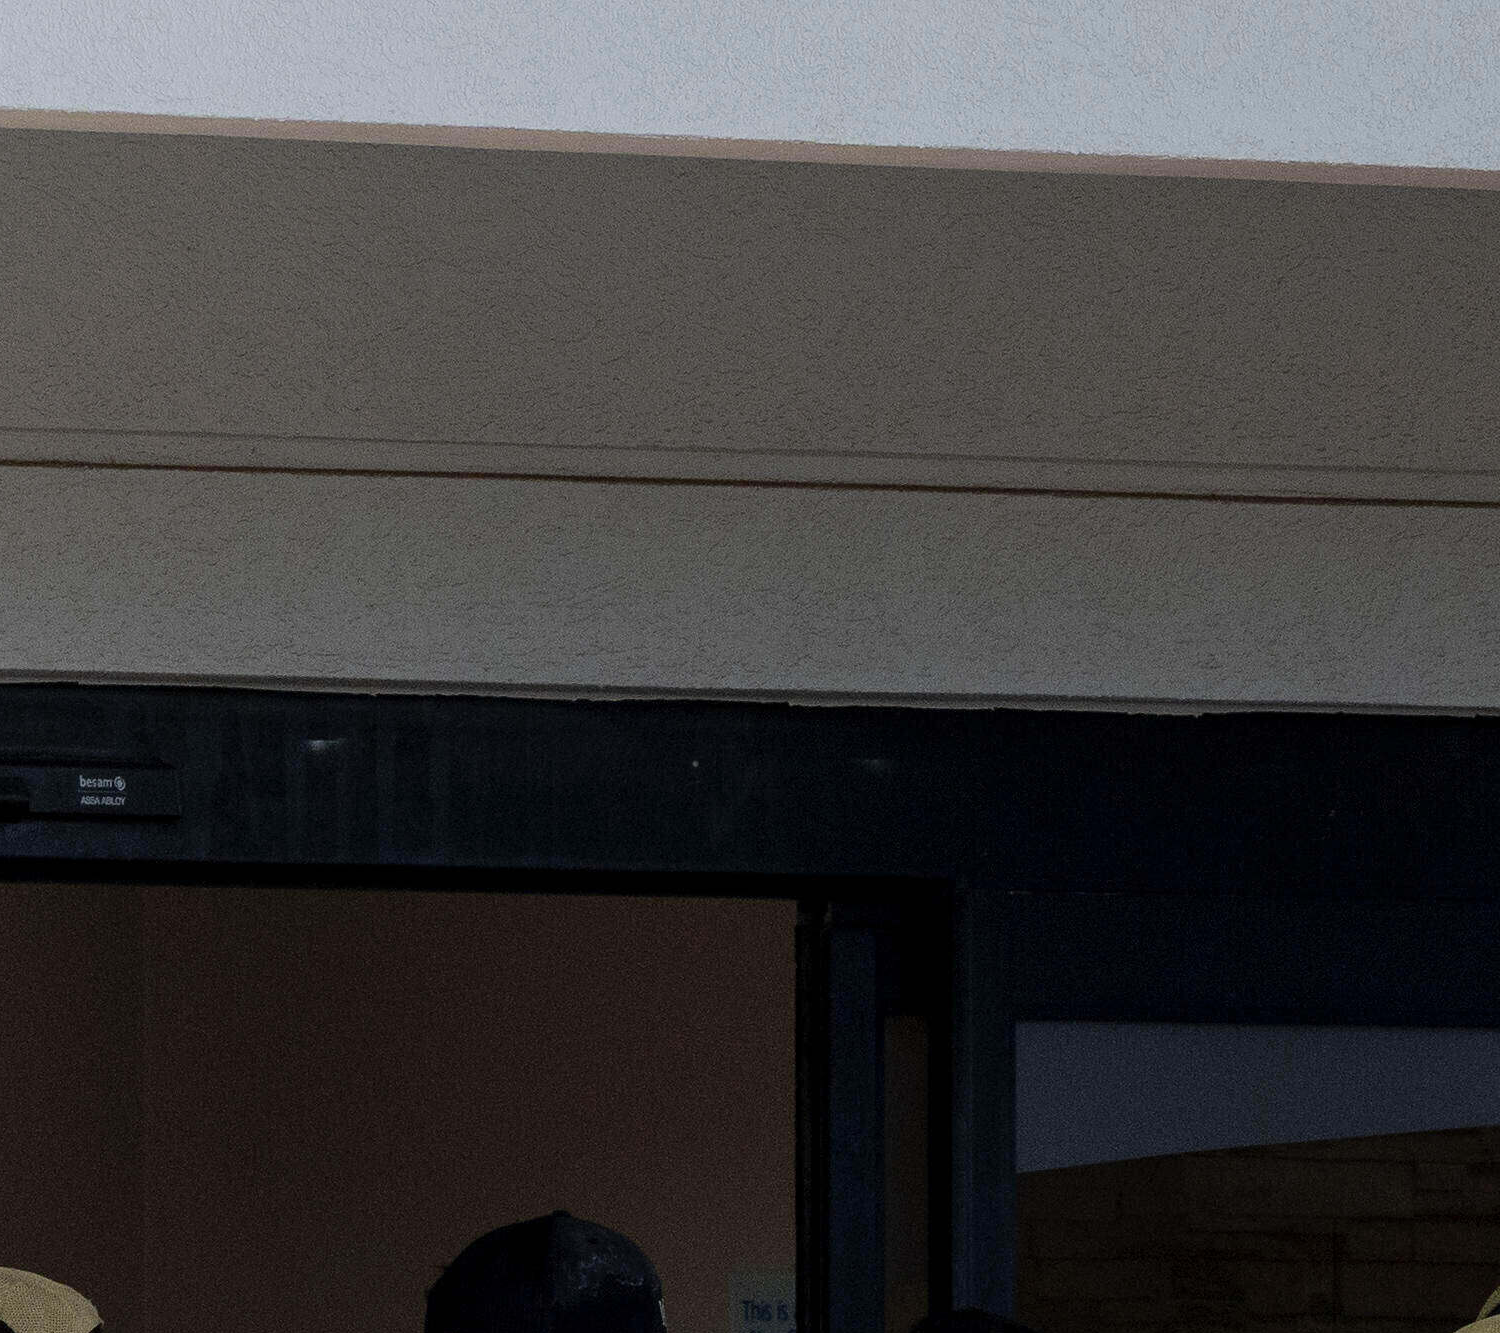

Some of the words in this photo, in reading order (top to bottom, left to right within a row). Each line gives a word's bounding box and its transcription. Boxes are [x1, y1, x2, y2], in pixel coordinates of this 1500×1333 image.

[79, 775, 113, 788] besam
[80, 796, 100, 805] ASSA
[101, 796, 126, 806] ABLOY
[743, 1301, 772, 1321] This
